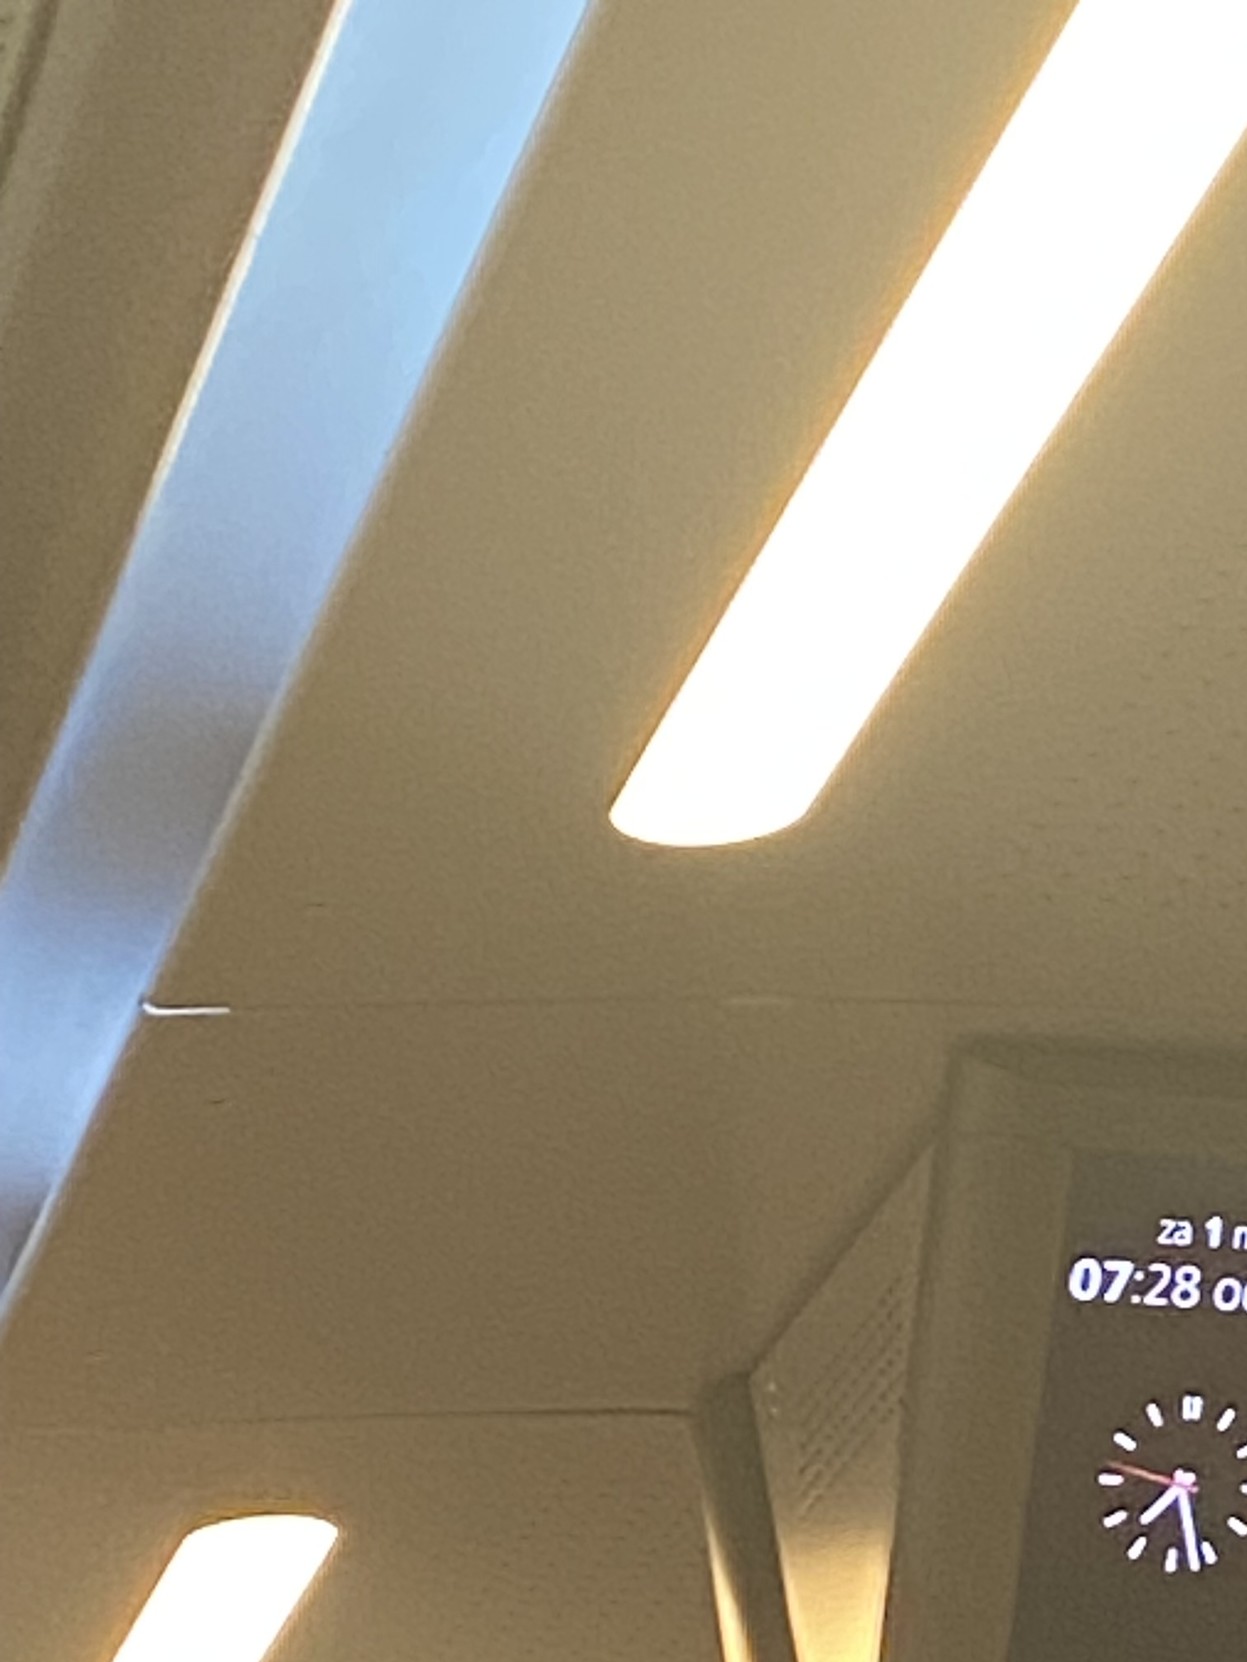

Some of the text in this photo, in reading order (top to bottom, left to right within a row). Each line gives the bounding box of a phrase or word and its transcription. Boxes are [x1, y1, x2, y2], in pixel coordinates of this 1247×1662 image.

[1157, 1218, 1194, 1247] za
[1205, 1216, 1223, 1249] 1
[1069, 1257, 1201, 1309] 07:28
